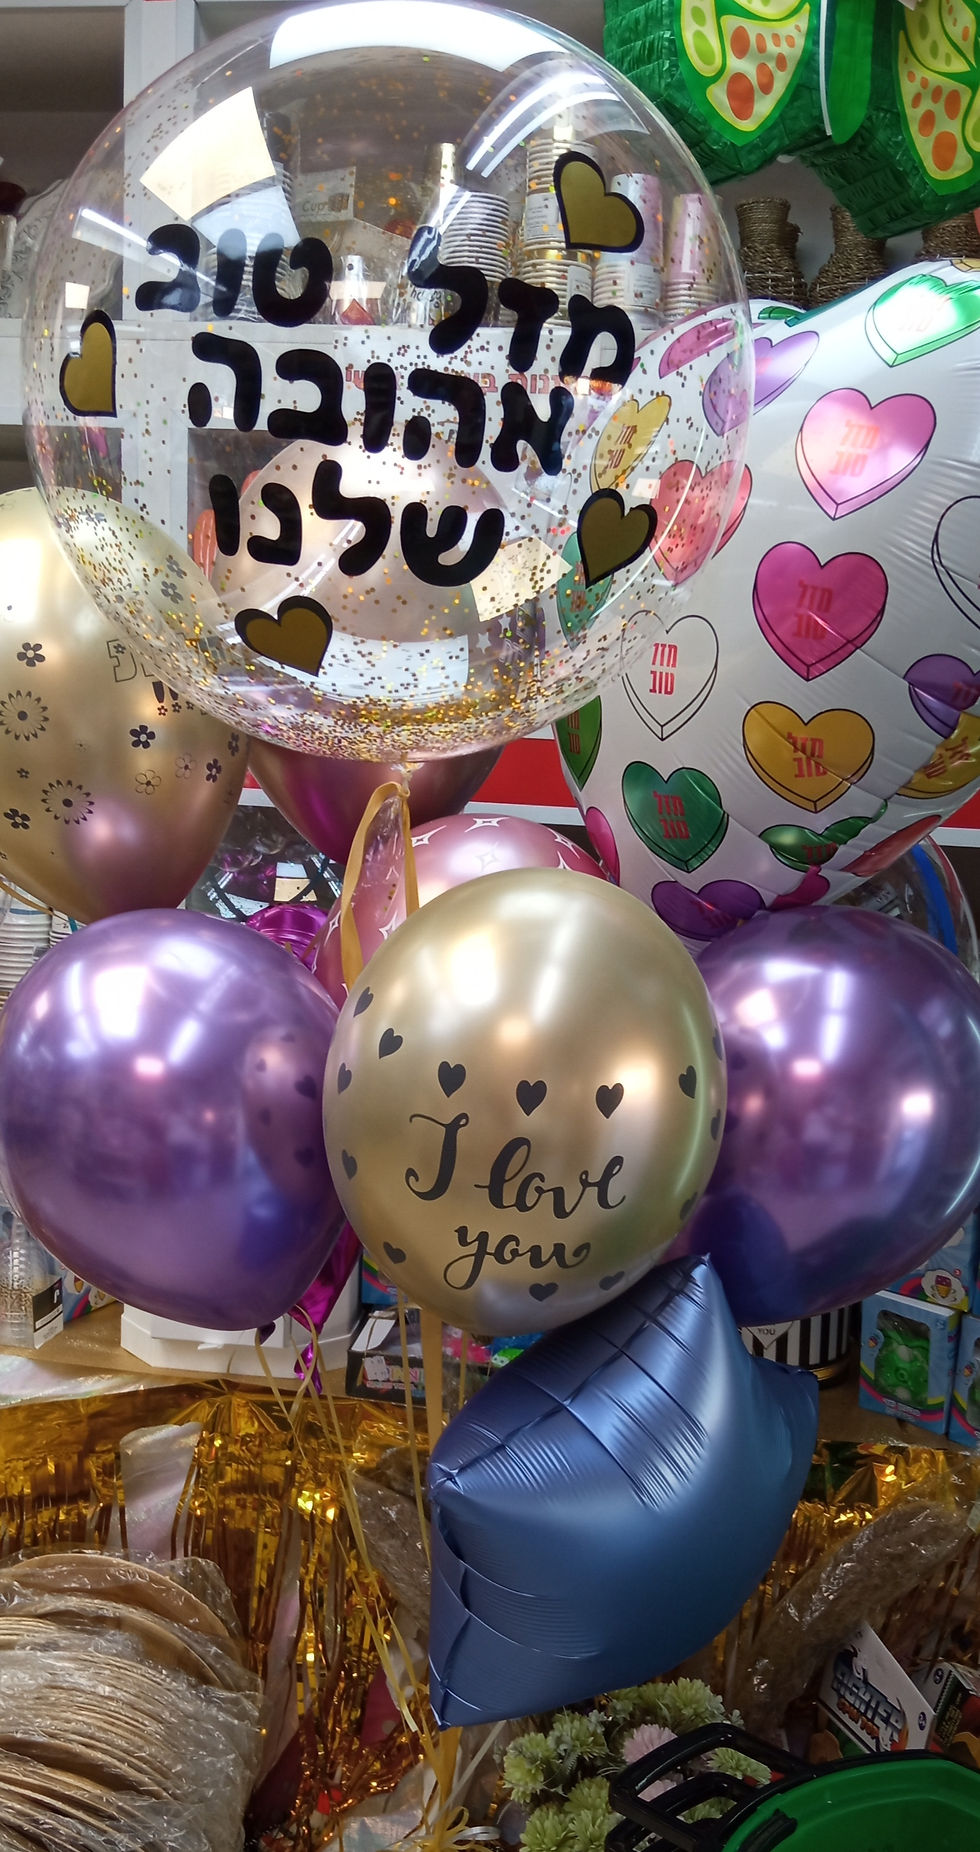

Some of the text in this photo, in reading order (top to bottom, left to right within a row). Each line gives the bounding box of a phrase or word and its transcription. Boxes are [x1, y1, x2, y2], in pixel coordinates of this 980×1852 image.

[134, 223, 333, 327] טוב
[187, 331, 574, 476] אהובה
[208, 459, 506, 587] שלנו
[797, 580, 834, 613] מזל
[649, 670, 675, 696] טוב
[787, 731, 824, 759] מזל
[793, 757, 828, 778] טוב
[653, 790, 686, 817] מזל
[660, 818, 690, 839] טוב
[405, 1112, 627, 1220] I love
[443, 1225, 592, 1291] you
